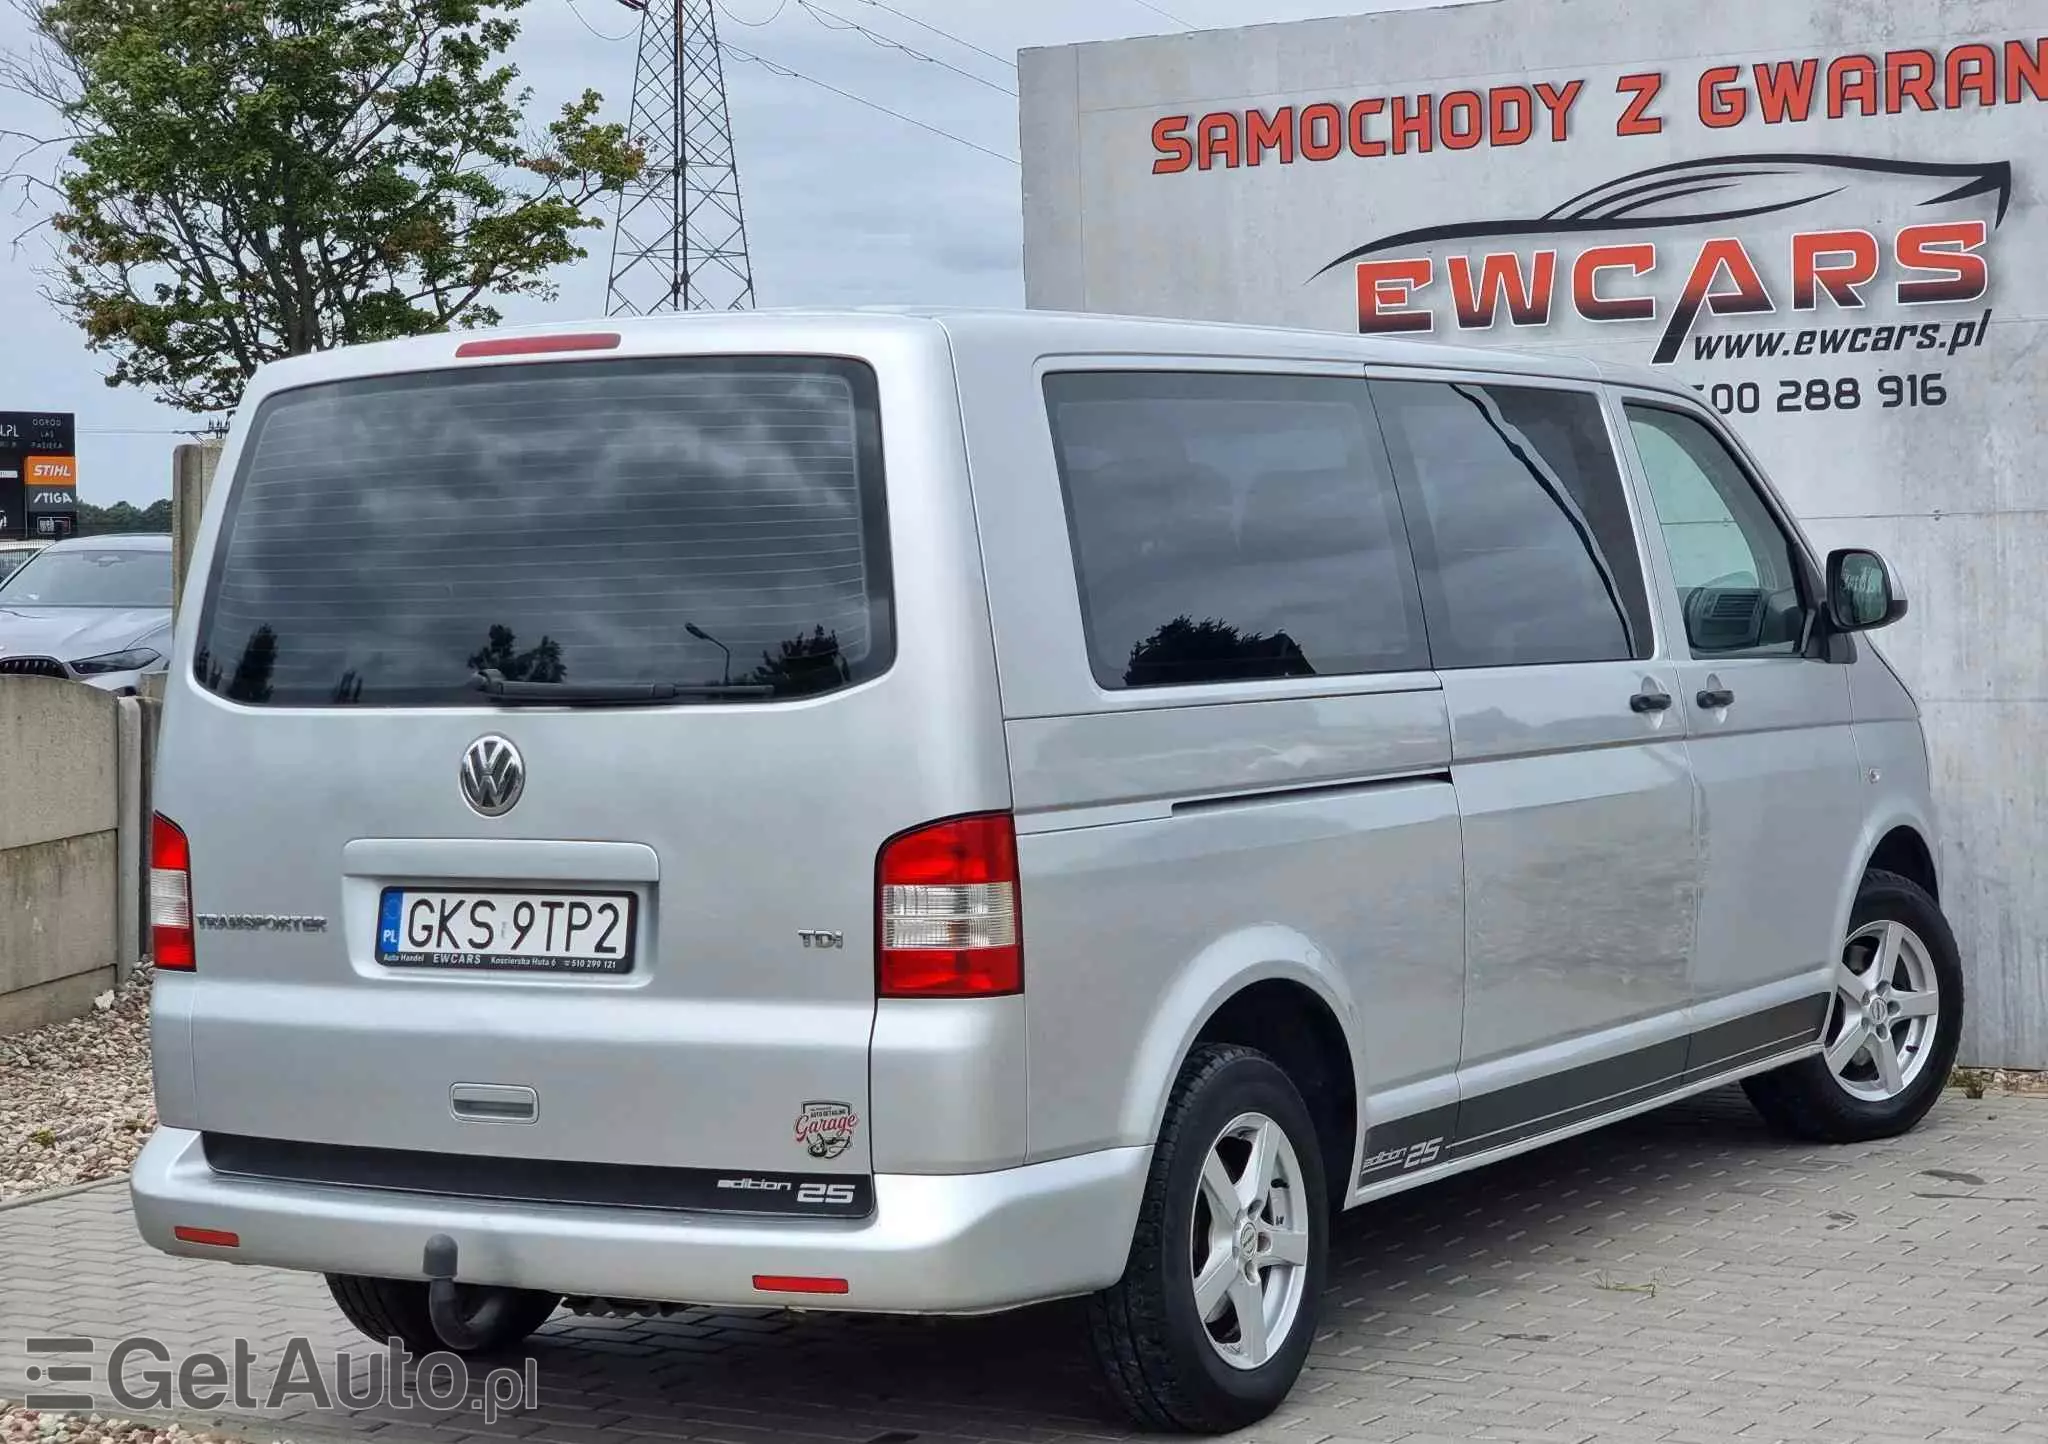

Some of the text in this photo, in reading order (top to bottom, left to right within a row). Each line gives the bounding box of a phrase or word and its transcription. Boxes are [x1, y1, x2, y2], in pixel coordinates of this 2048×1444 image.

[1151, 37, 2048, 175] SAMOCHODY Z GWARAN
[1356, 219, 1988, 366] EWCARS
[1694, 308, 1992, 361] www.ewcars.pl
[1692, 373, 1947, 415] 00 288 916
[33, 464, 72, 477] STIHL
[33, 492, 73, 504] STIGA
[196, 912, 327, 933] TRANSPORTER
[383, 929, 398, 943] PL
[407, 898, 620, 954] GKS 9TP2
[798, 929, 843, 949] TDI
[400, 954, 425, 963] Handel
[433, 953, 481, 965] EWCARS
[571, 960, 585, 968] 510
[795, 1112, 857, 1143] Garage
[1362, 1136, 1445, 1170] edition 25
[717, 1178, 856, 1204] edition 25
